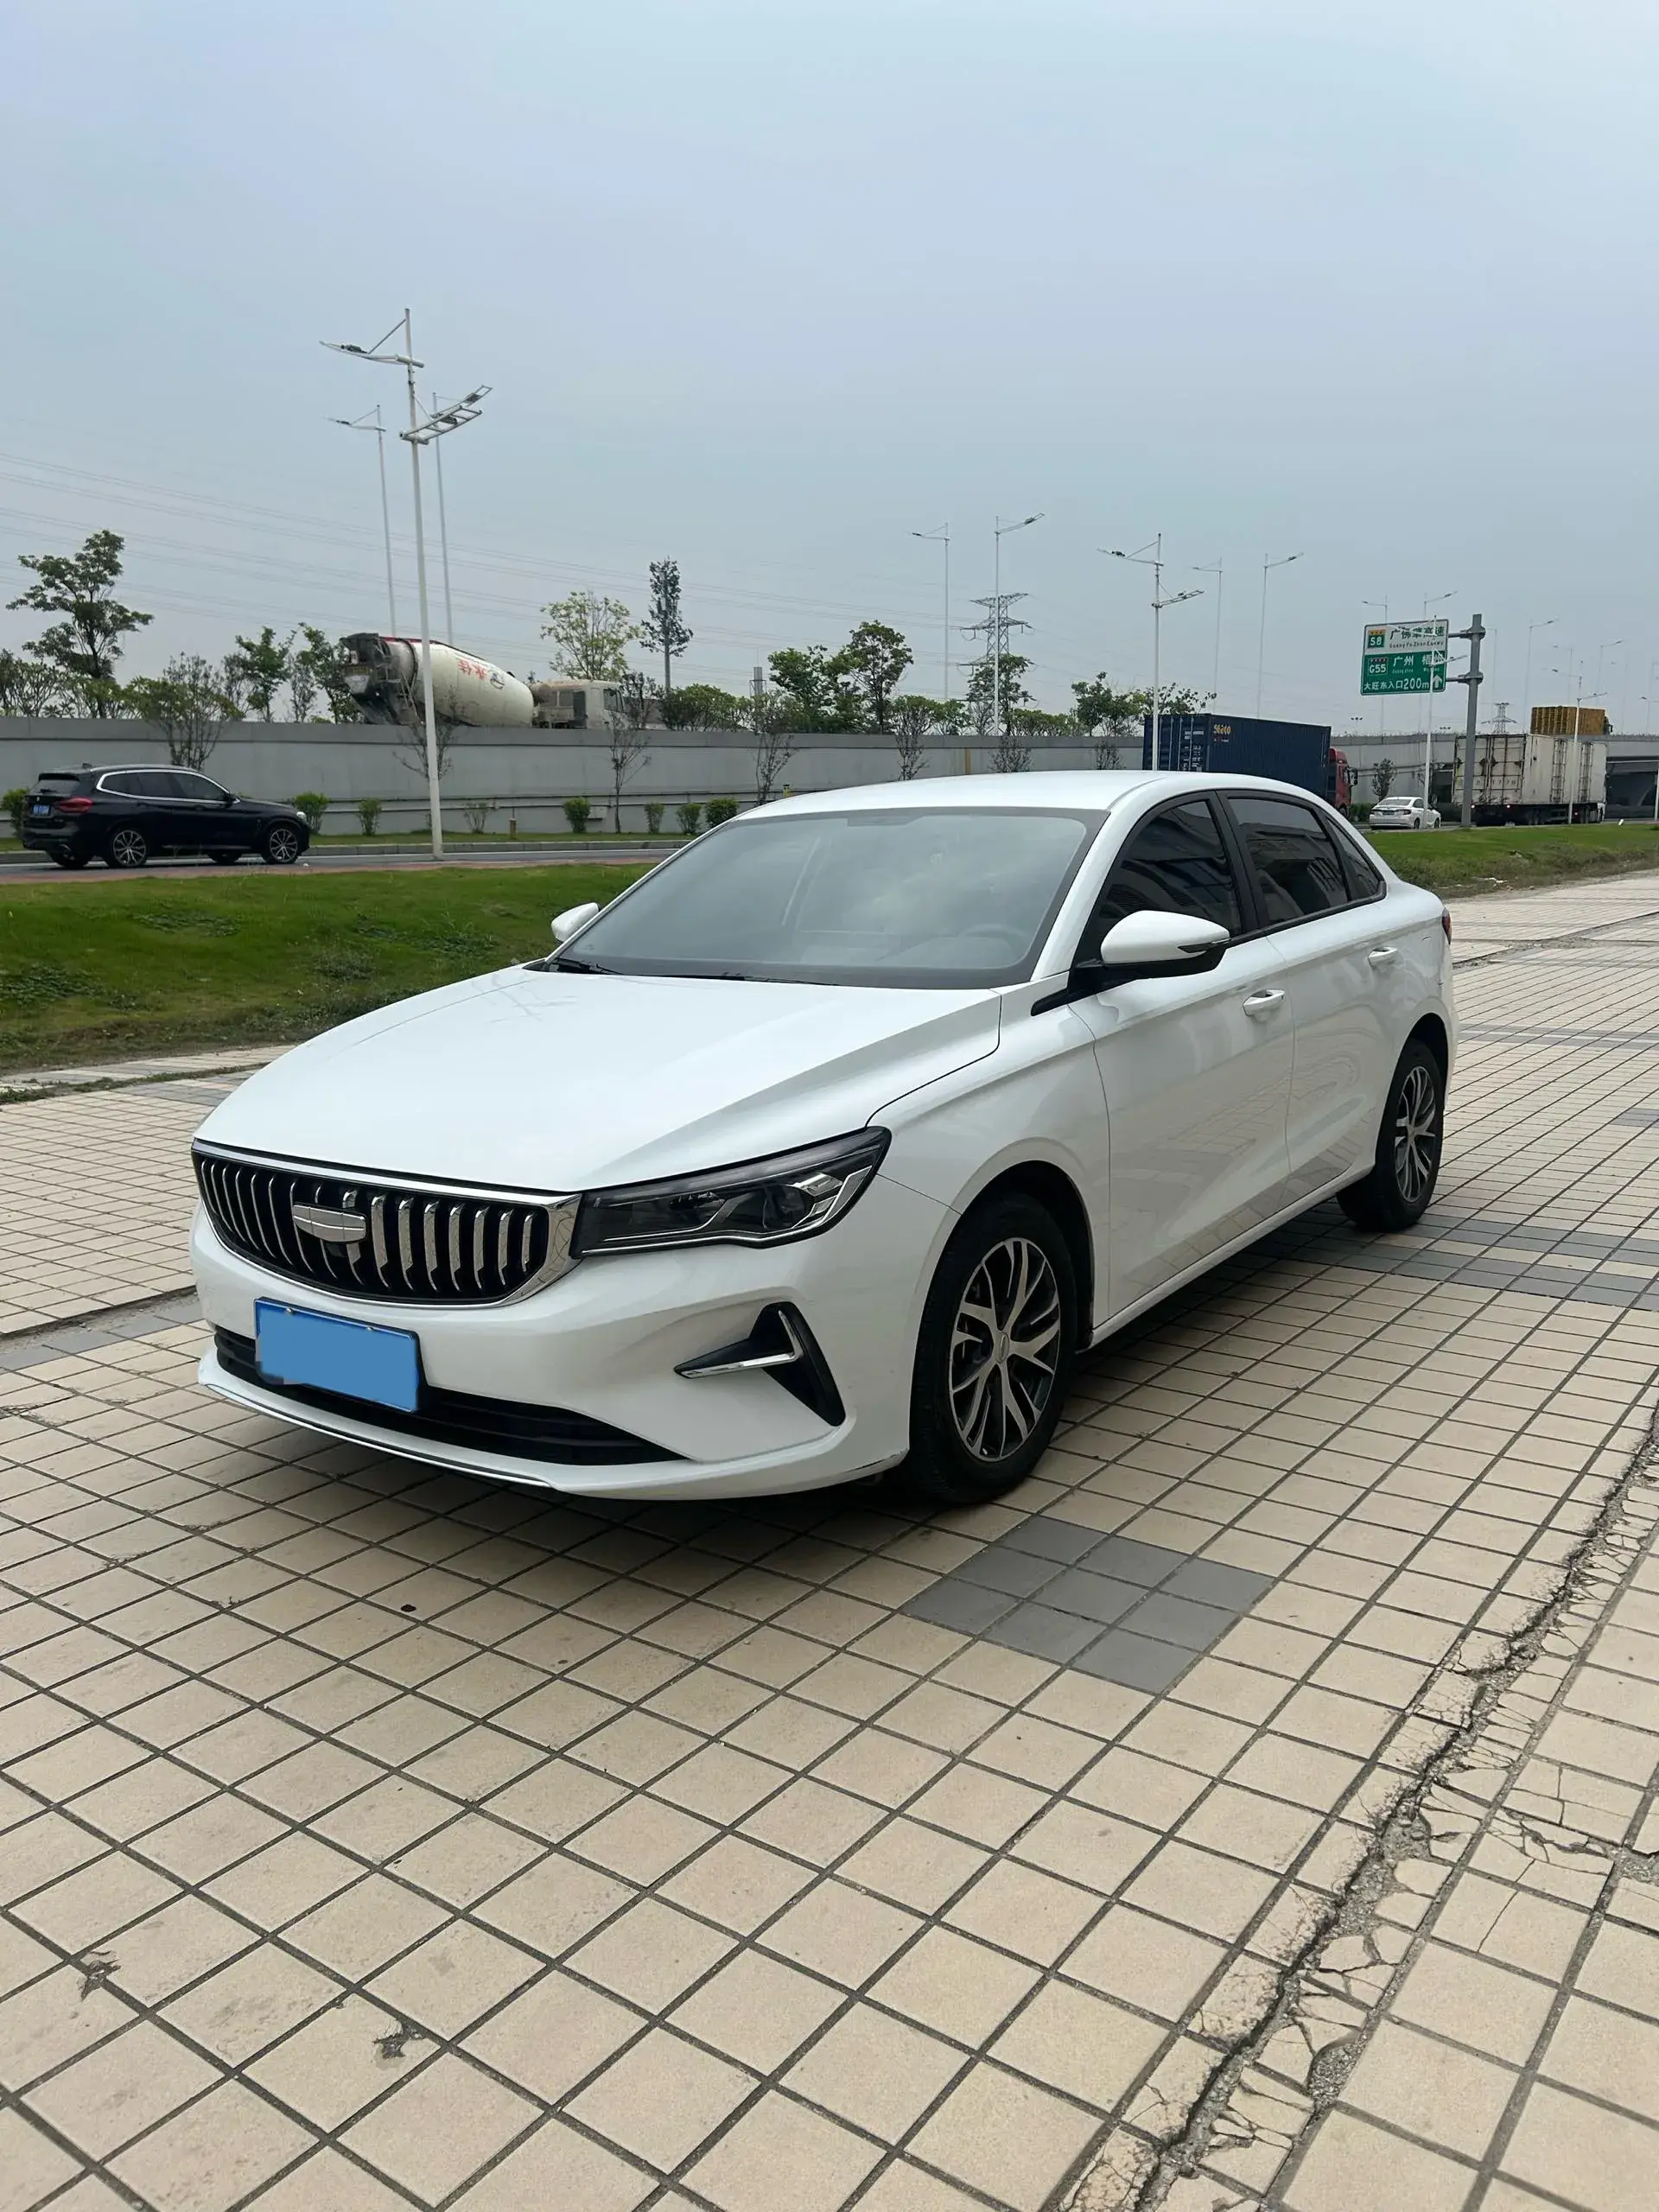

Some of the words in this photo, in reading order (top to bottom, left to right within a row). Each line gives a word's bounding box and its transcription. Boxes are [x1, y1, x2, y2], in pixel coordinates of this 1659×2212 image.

[1370, 636, 1382, 646] S8
[1393, 655, 1414, 667] 广州
[1369, 664, 1386, 674] G55
